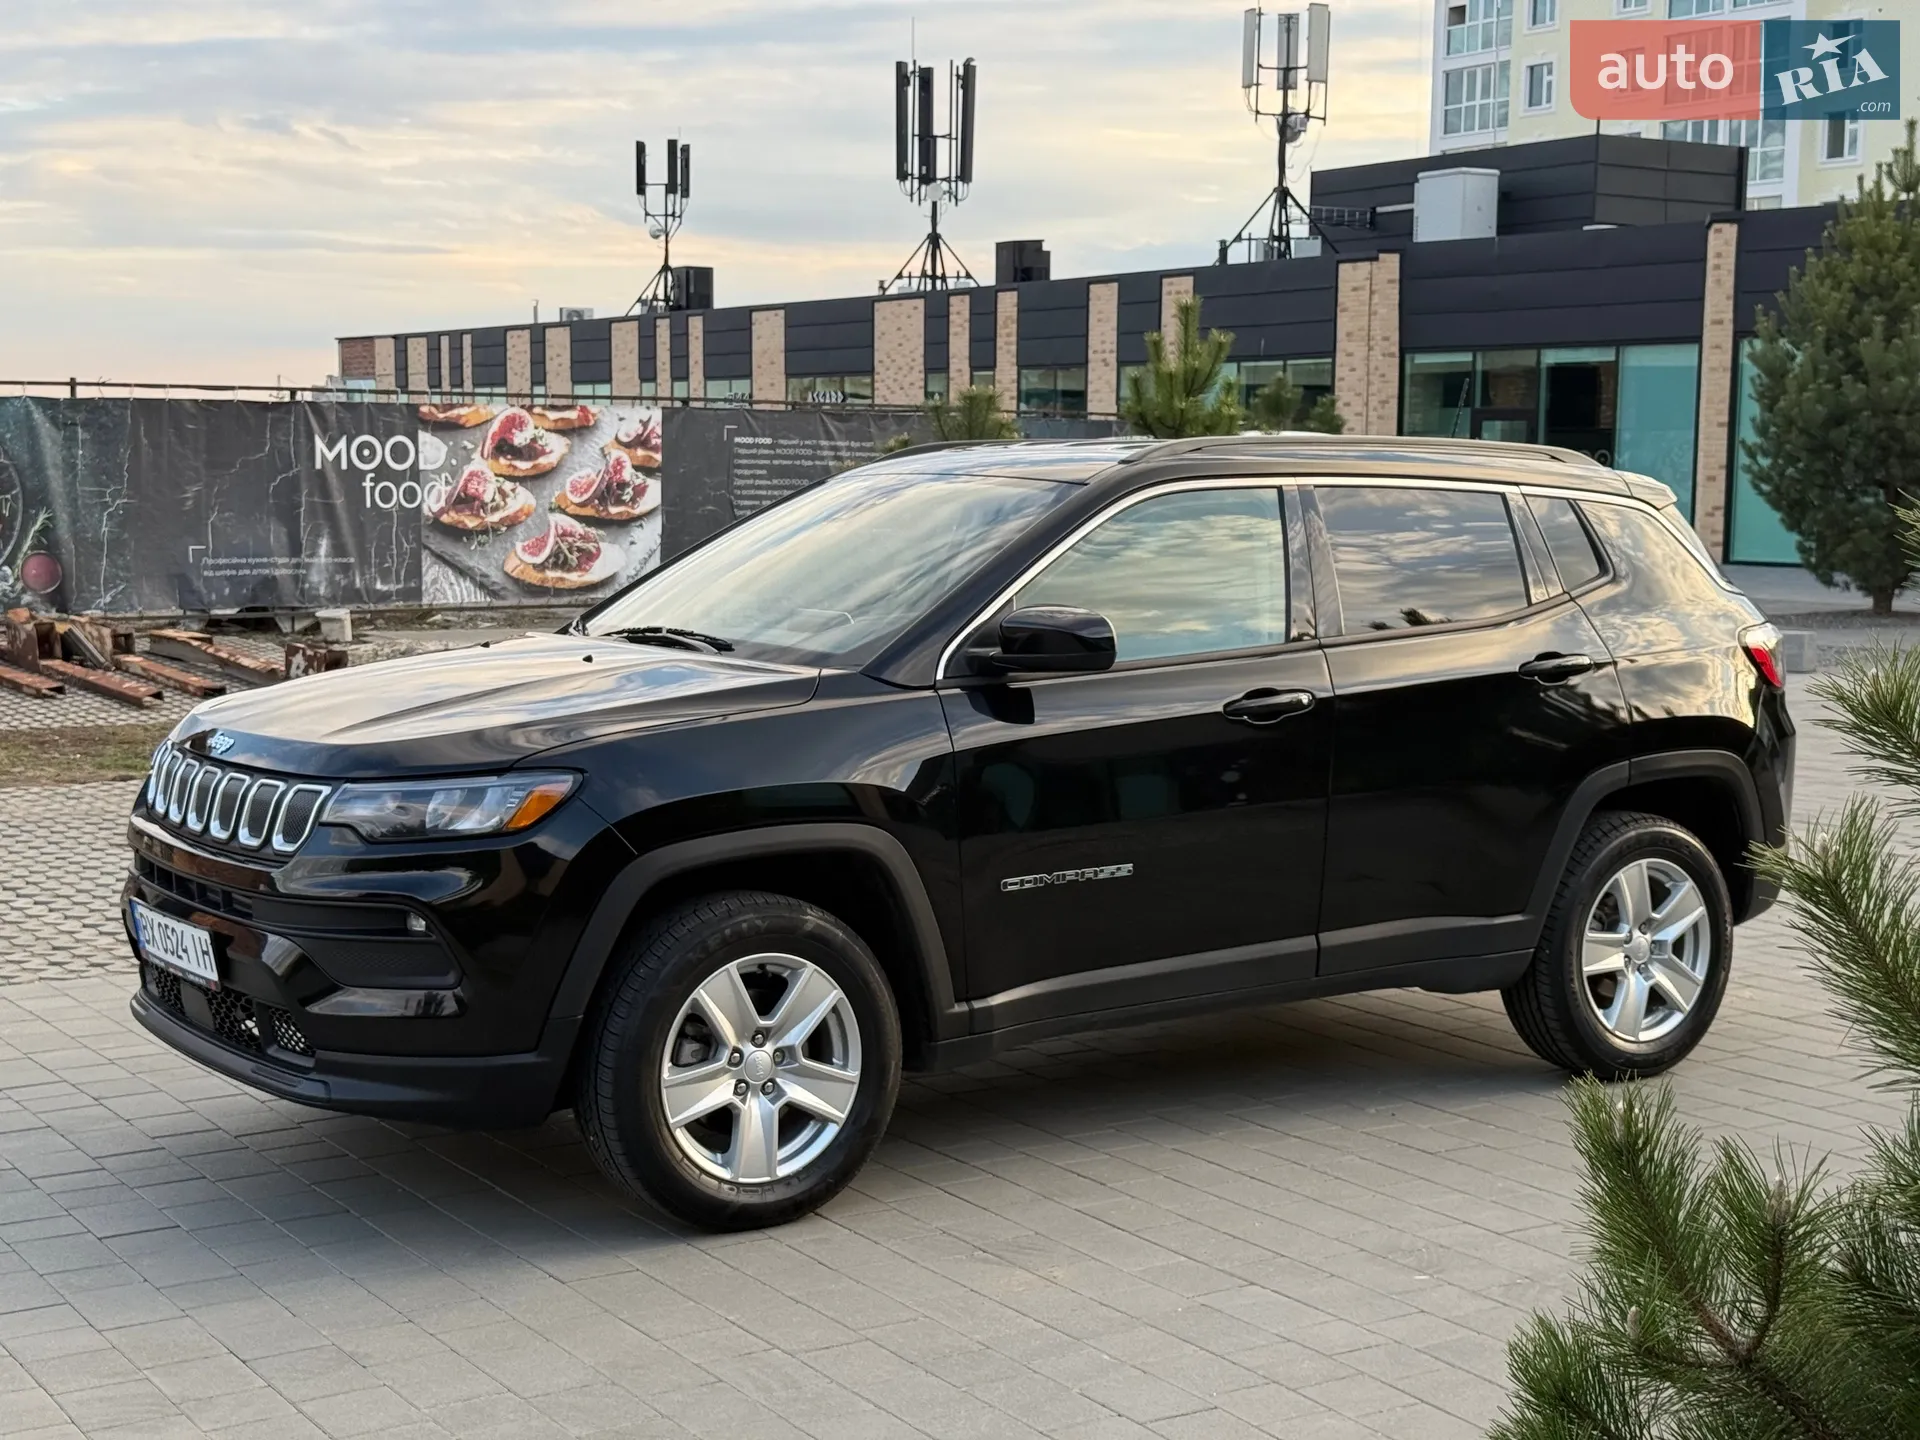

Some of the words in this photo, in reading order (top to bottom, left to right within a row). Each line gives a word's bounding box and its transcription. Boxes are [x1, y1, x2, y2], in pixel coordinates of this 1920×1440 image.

[314, 430, 448, 471] MOOD
[362, 472, 448, 509] food
[1001, 863, 1133, 892] COMPASS
[157, 920, 192, 964] 0524
